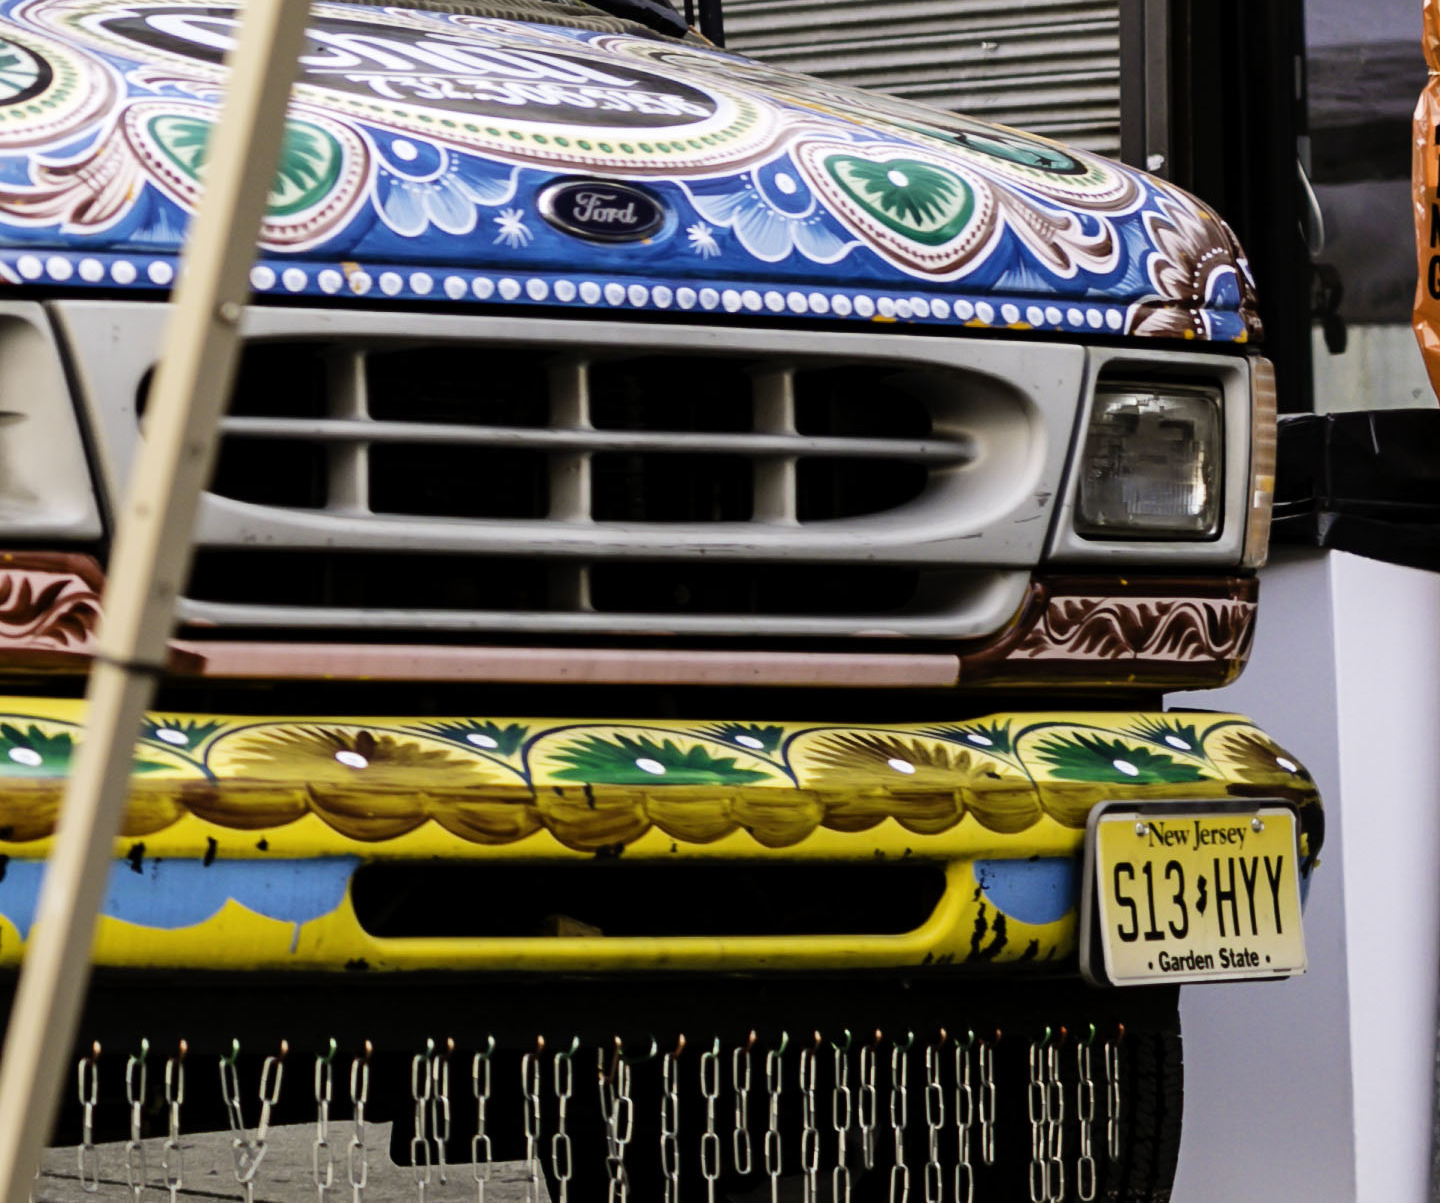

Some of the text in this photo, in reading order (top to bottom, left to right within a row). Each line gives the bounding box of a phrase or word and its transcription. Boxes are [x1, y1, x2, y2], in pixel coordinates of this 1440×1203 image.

[573, 191, 638, 227] Ford
[1148, 820, 1247, 851] New Jersey
[1158, 948, 1260, 973] Garden State
